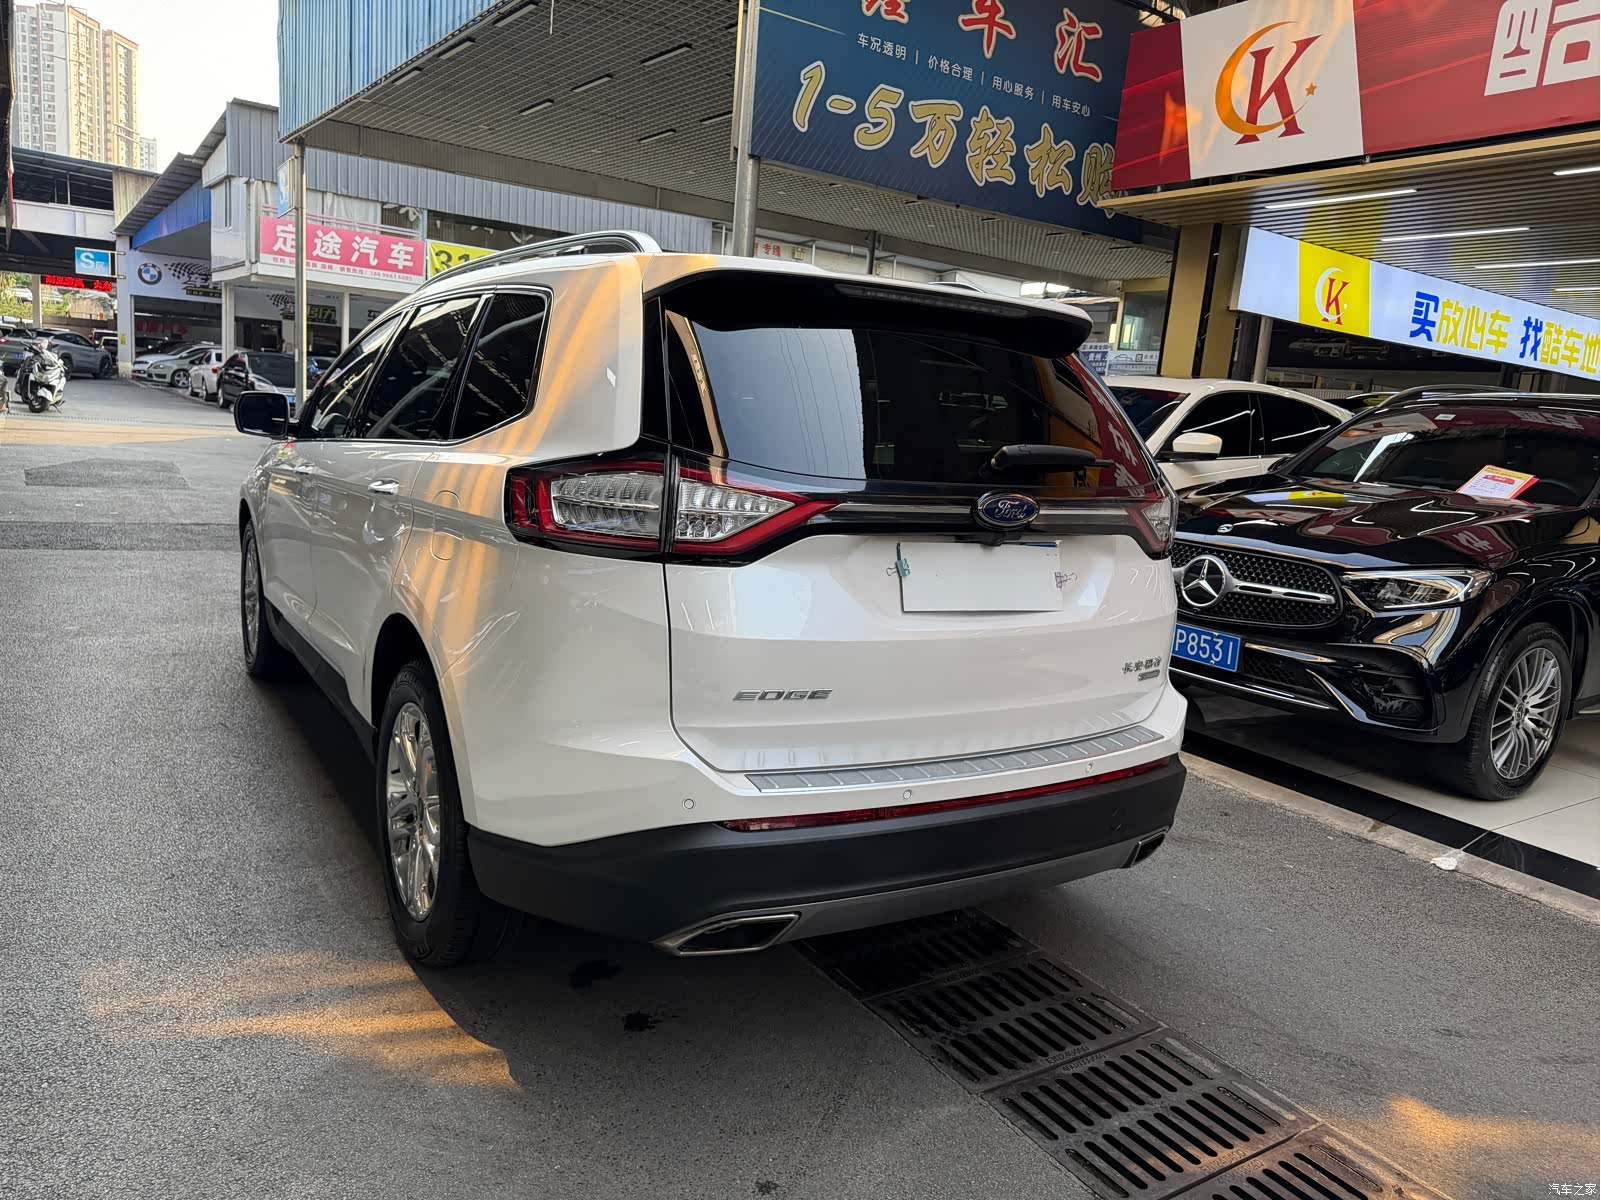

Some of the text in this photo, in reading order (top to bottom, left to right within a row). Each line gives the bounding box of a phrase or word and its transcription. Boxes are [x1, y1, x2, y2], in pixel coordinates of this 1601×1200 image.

[857, 32, 1091, 117] 车况透明 价格合理 用心服务 用车安心
[1409, 291, 1512, 355] 买放心车
[994, 499, 1027, 519] Ford
[1175, 628, 1233, 665] P8531
[733, 688, 833, 701] EDGE
